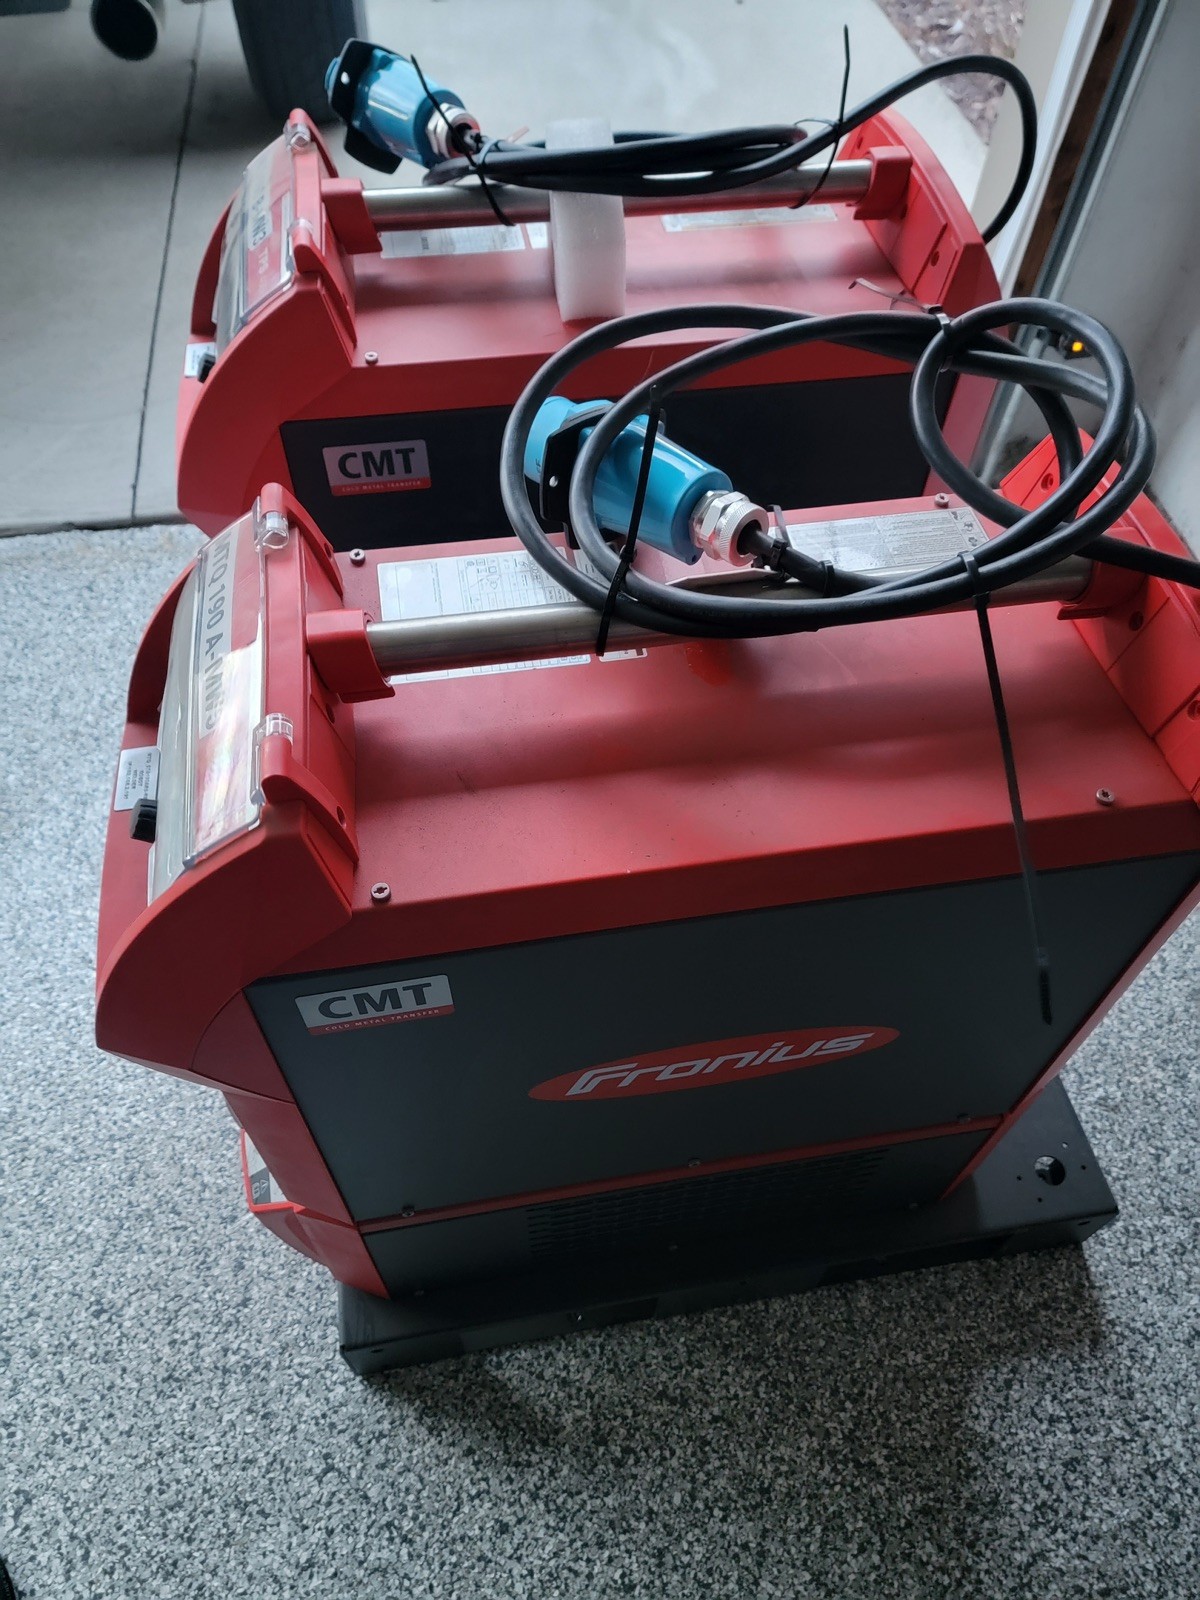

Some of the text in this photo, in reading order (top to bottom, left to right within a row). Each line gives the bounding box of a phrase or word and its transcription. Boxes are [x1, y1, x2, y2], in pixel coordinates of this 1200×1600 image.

[338, 448, 415, 478] CMT
[206, 583, 226, 630] 190
[318, 983, 432, 1019] CMT
[325, 1009, 440, 1032] COLD METAL TRANSFER
[565, 1032, 875, 1096] Fronius
